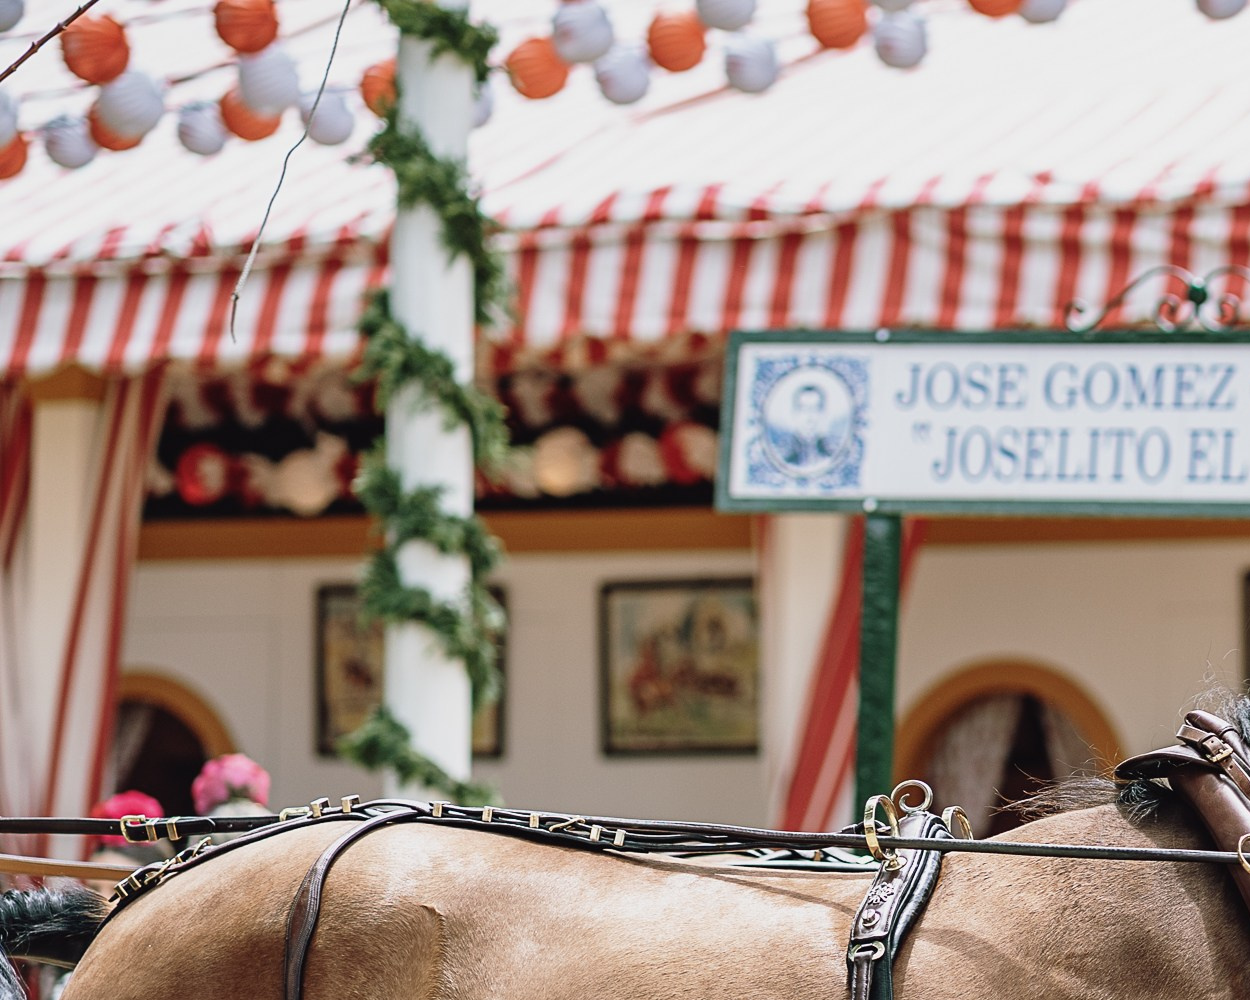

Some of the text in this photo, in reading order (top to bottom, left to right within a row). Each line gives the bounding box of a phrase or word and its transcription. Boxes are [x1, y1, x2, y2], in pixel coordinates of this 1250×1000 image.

[895, 361, 1028, 412] JOSE
[1042, 361, 1237, 412] GOMEZ
[1185, 427, 1248, 485] EL
